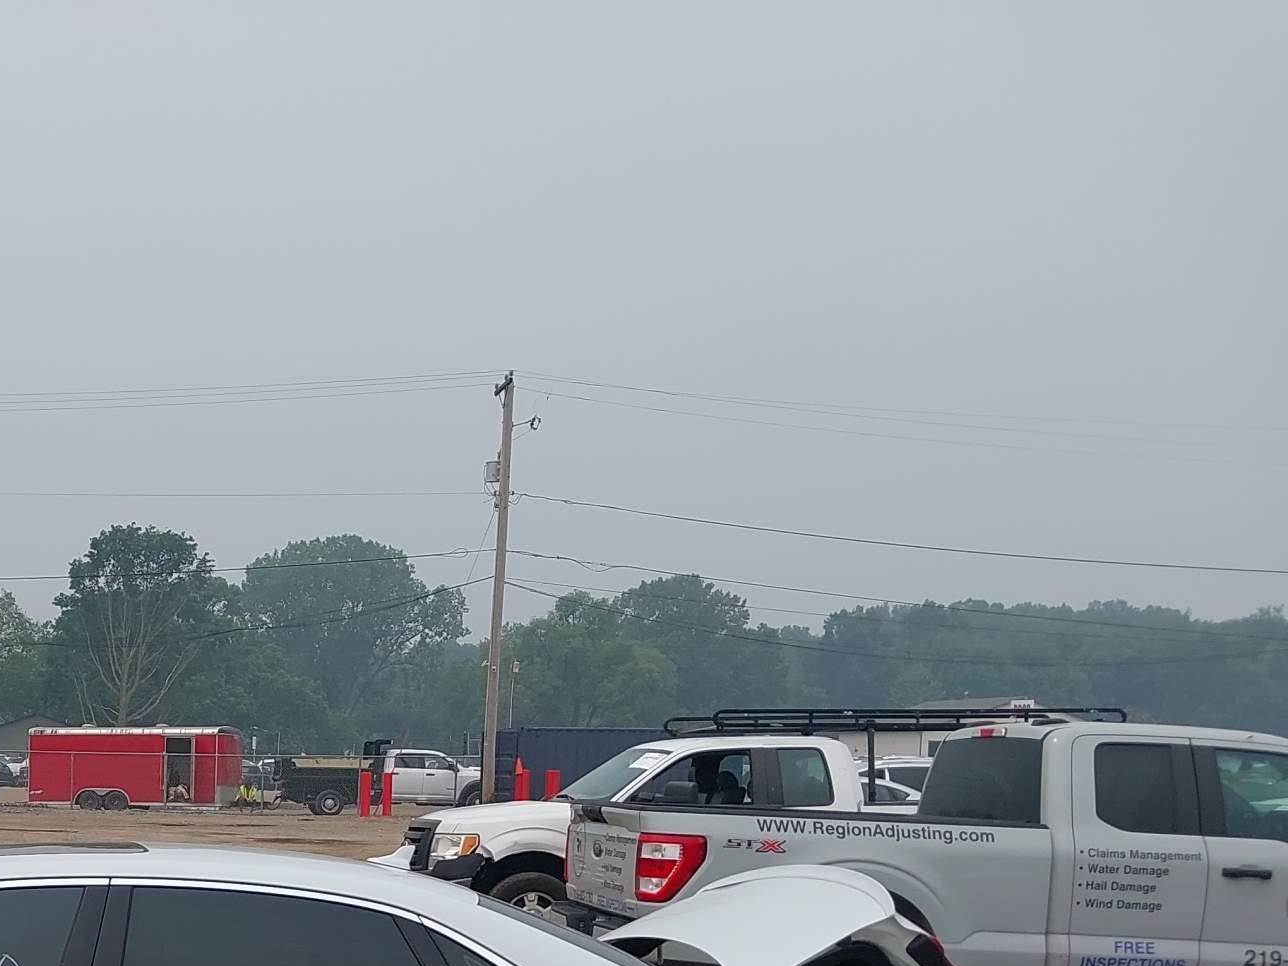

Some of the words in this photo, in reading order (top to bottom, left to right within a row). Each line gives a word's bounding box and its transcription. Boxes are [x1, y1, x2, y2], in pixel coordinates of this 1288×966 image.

[756, 819, 995, 845] WWW.RegionAdjusting.com
[723, 838, 787, 854] STX
[1087, 848, 1126, 859] Claims
[1130, 850, 1202, 862] Management
[1088, 864, 1121, 875] Water
[1123, 866, 1170, 878] Damage
[1085, 881, 1107, 891] Hail
[1111, 882, 1157, 894] Damage
[1085, 899, 1113, 910] Wind
[1116, 900, 1163, 912] Damage
[1114, 941, 1156, 955] FREE
